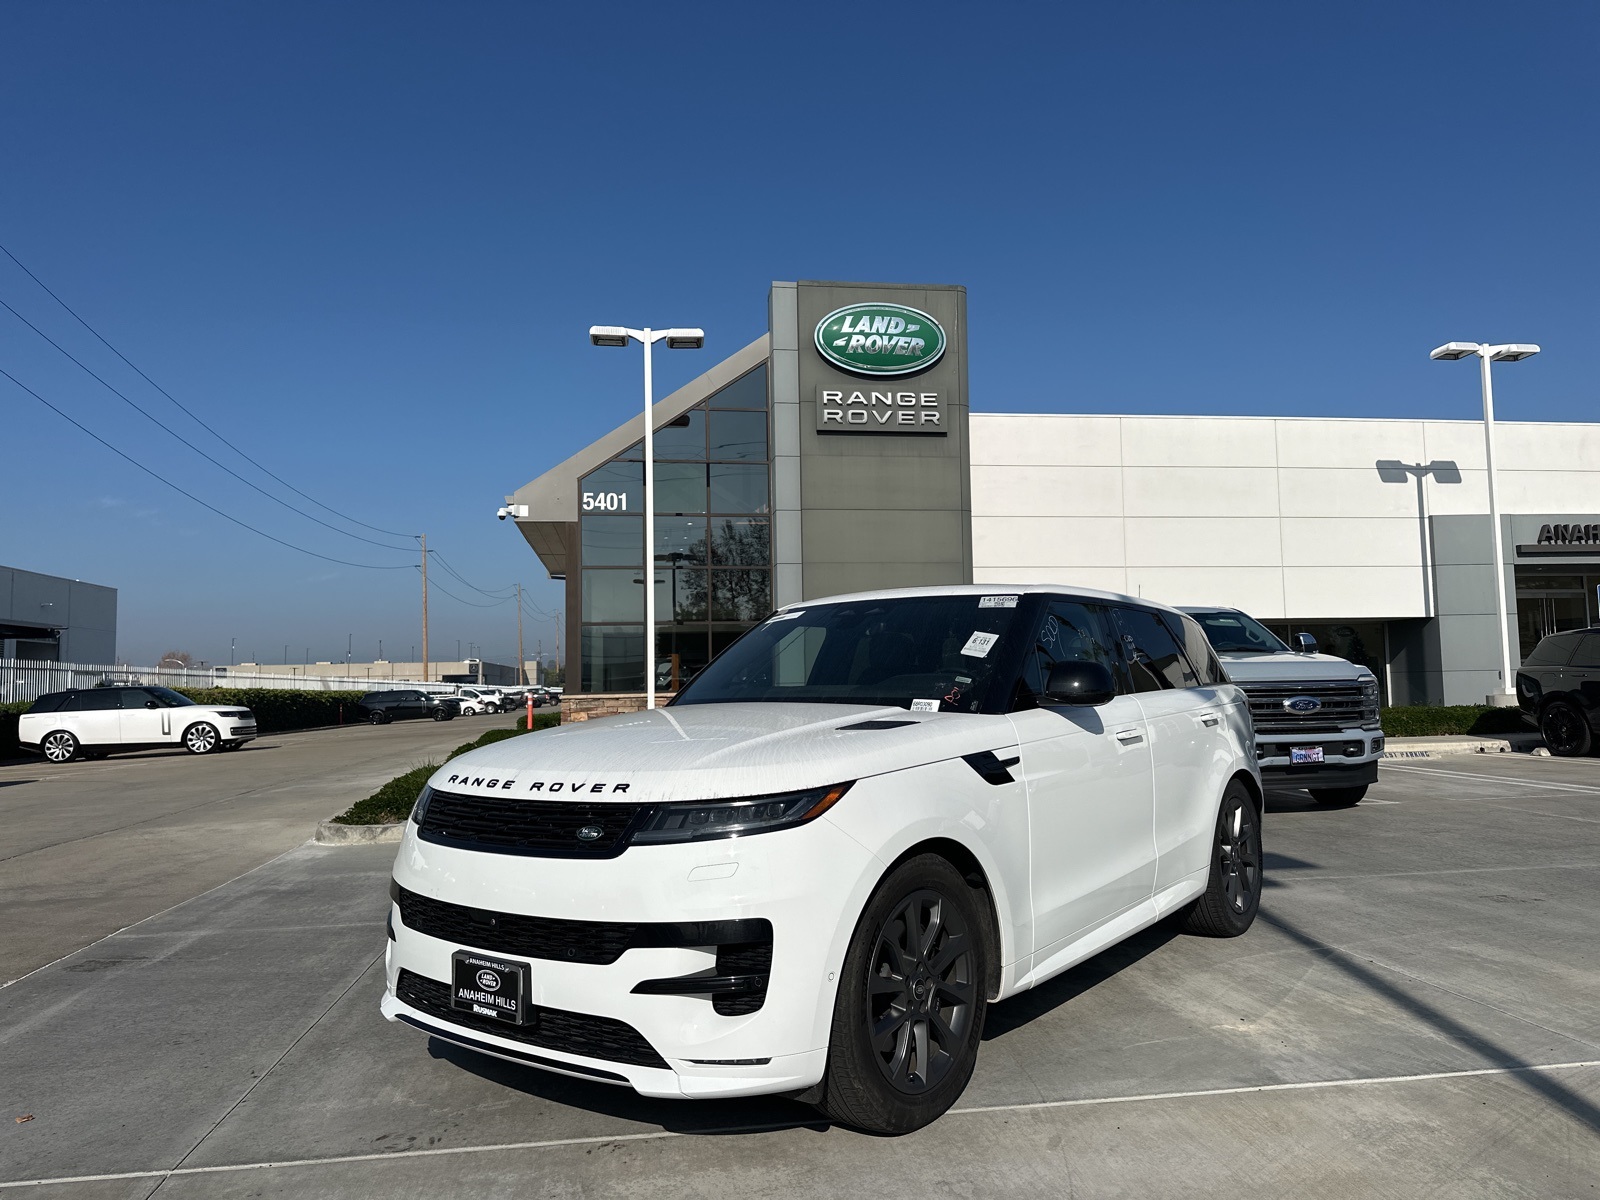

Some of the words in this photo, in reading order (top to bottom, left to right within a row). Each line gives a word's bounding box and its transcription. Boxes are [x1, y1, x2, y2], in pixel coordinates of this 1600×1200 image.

[840, 315, 906, 334] LAND
[846, 334, 926, 357] ROVER
[822, 390, 938, 407] RANGE
[822, 409, 941, 426] ROVER
[582, 492, 627, 511] 5401
[447, 774, 516, 790] RANGE
[529, 781, 631, 794] ROVER
[469, 958, 491, 967] ANAHEIM
[491, 962, 505, 971] HILLS
[458, 988, 494, 1004] ANAHEIM
[495, 995, 516, 1010] HILLS
